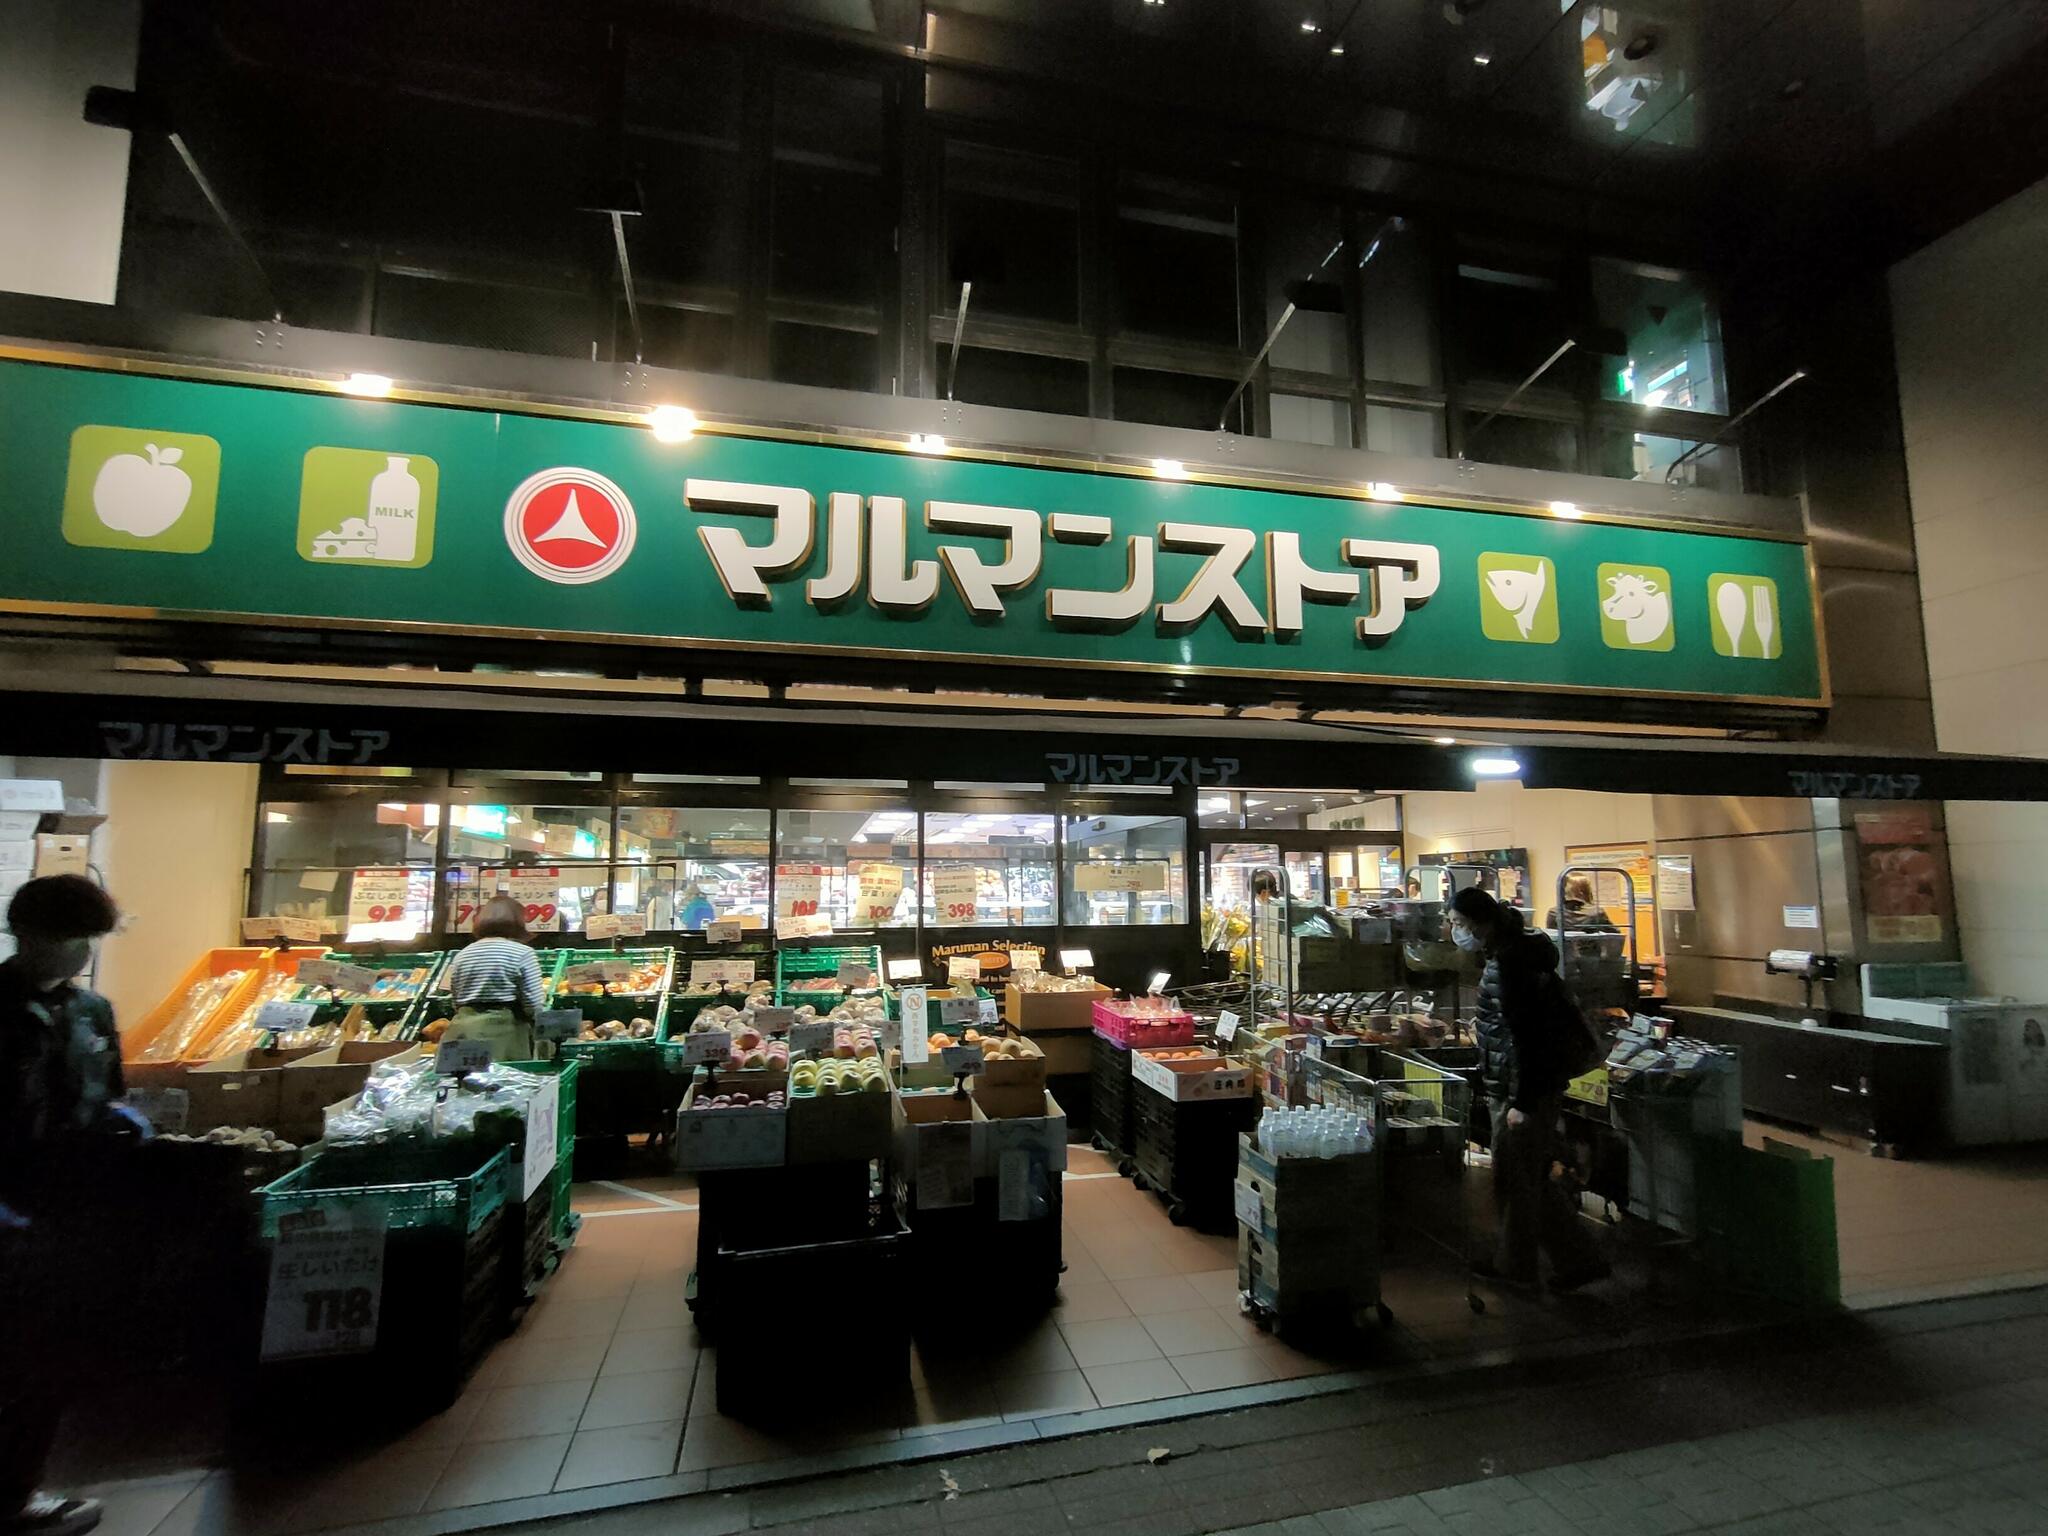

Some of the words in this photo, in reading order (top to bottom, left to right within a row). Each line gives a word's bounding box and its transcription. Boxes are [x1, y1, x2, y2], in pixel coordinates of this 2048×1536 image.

[374, 505, 415, 520] MILK
[684, 478, 1440, 638] マルマンストア
[98, 721, 390, 763] マルマンストア
[1045, 753, 1240, 786] マルマンストア
[354, 891, 406, 900] ぶなしめじ
[513, 891, 555, 900] エリンギ
[947, 902, 976, 918] 398
[931, 941, 989, 957] Maruman
[992, 939, 1046, 956] Selection
[303, 1287, 372, 1332] 118
